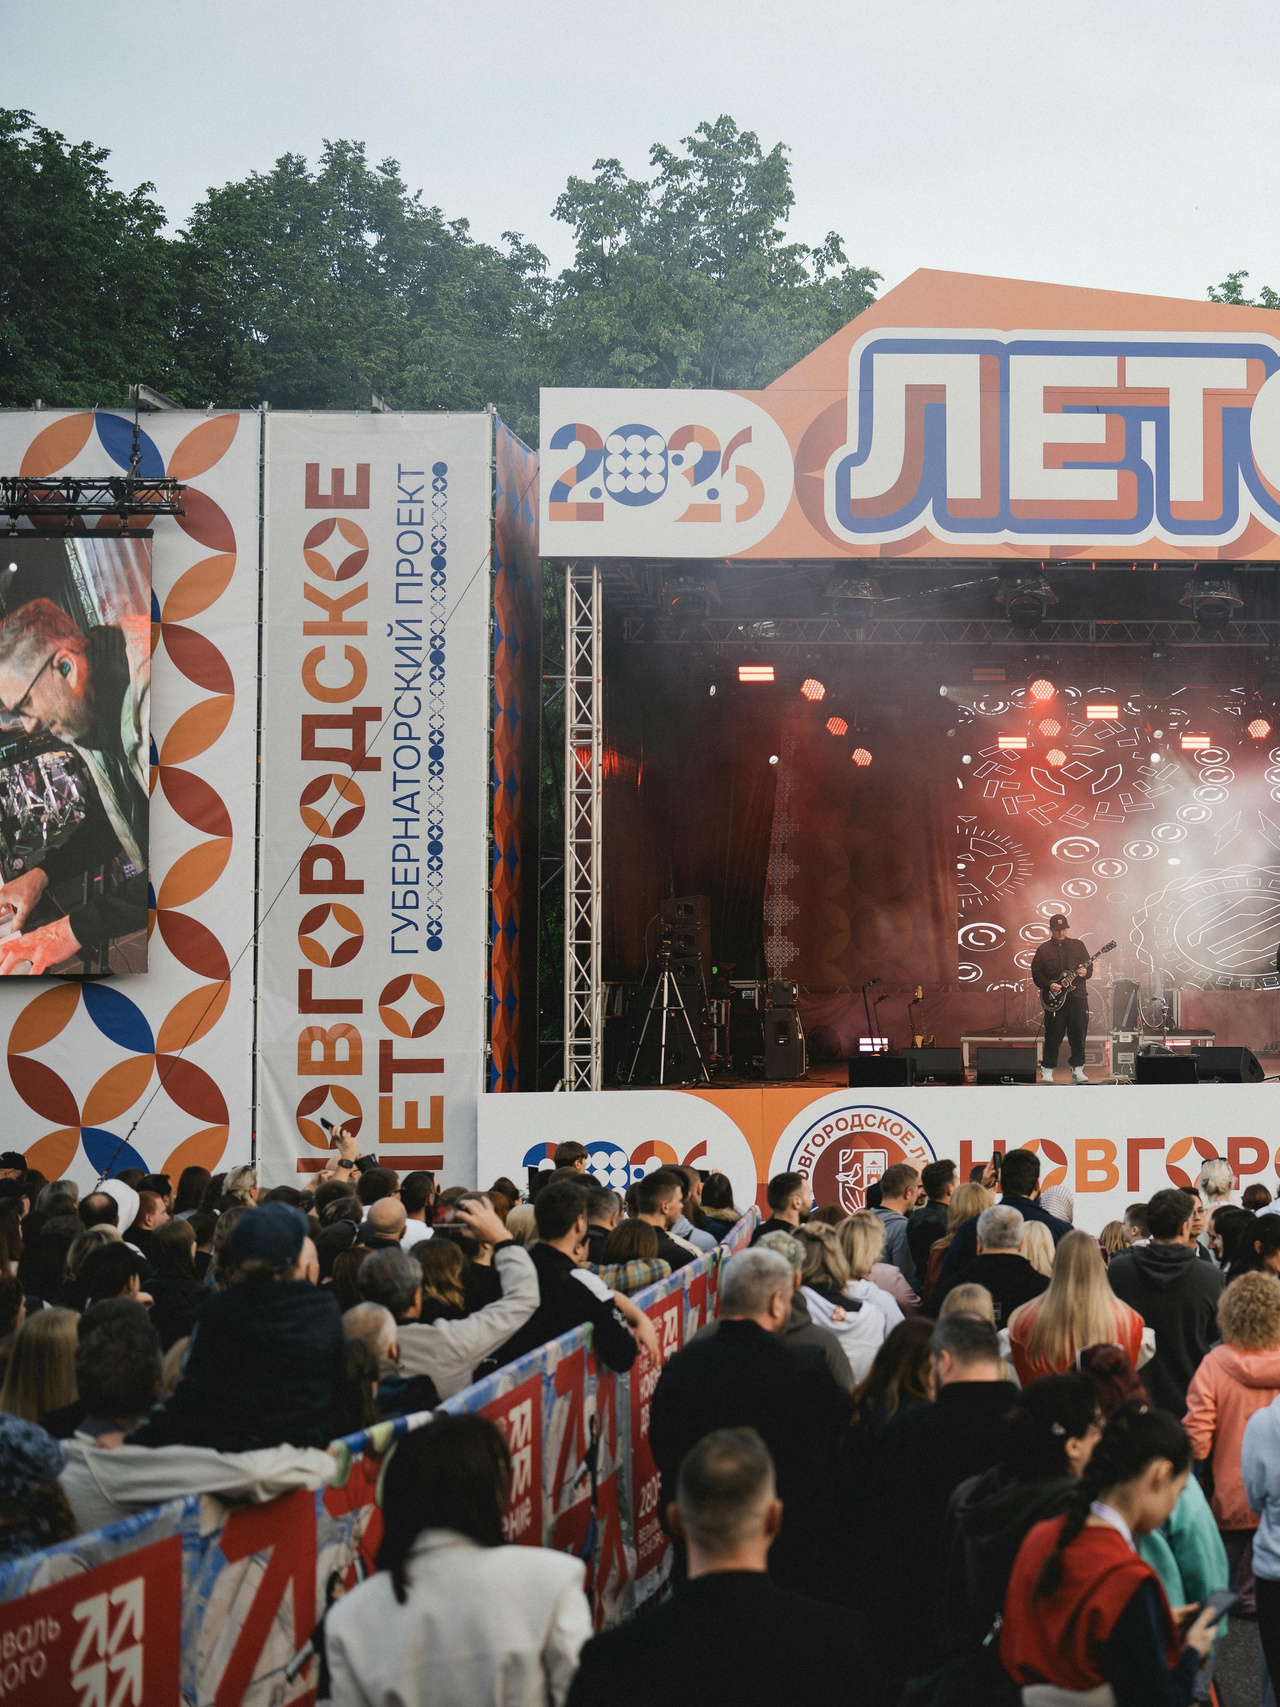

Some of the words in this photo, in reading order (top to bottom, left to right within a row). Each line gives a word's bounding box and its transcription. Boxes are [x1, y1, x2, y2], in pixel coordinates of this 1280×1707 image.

[395, 462, 425, 604] ПРОЕКТ
[548, 422, 766, 523] 2026
[387, 619, 424, 954] ГУБЕРНАТОРСКИЙ
[797, 1113, 915, 1180] ОВГОРОДСКОЕ
